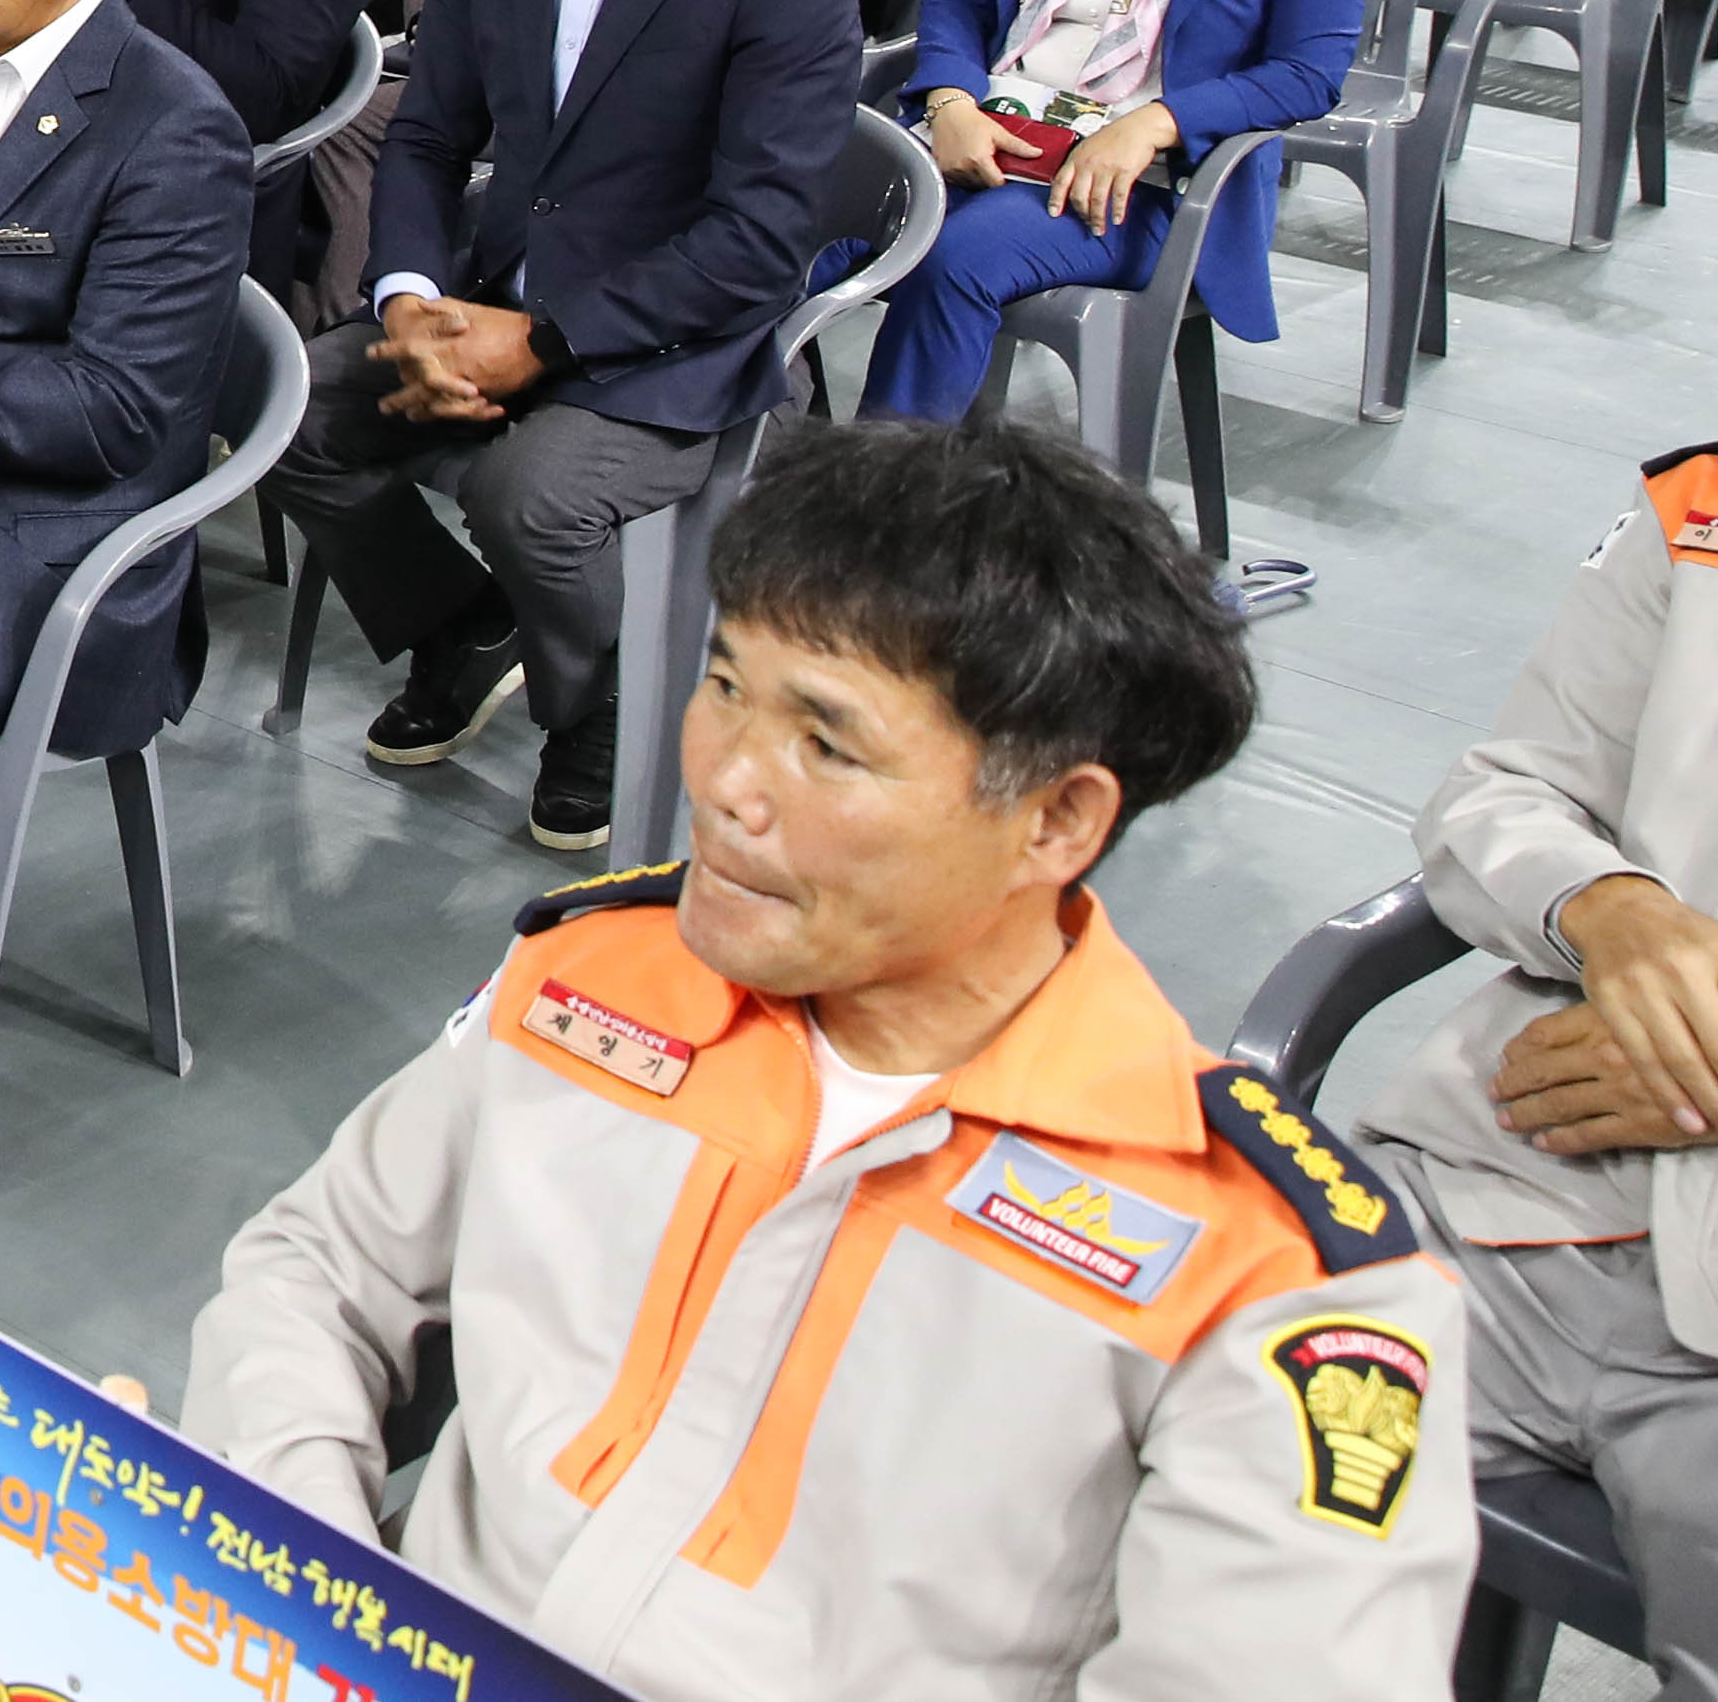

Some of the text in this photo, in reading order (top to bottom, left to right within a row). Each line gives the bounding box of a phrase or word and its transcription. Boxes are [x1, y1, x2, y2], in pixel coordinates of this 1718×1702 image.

[988, 1198, 1133, 1282] VOLUNTEER FIRE
[30, 1408, 203, 1536] 대도약!
[206, 1511, 298, 1595] 전남
